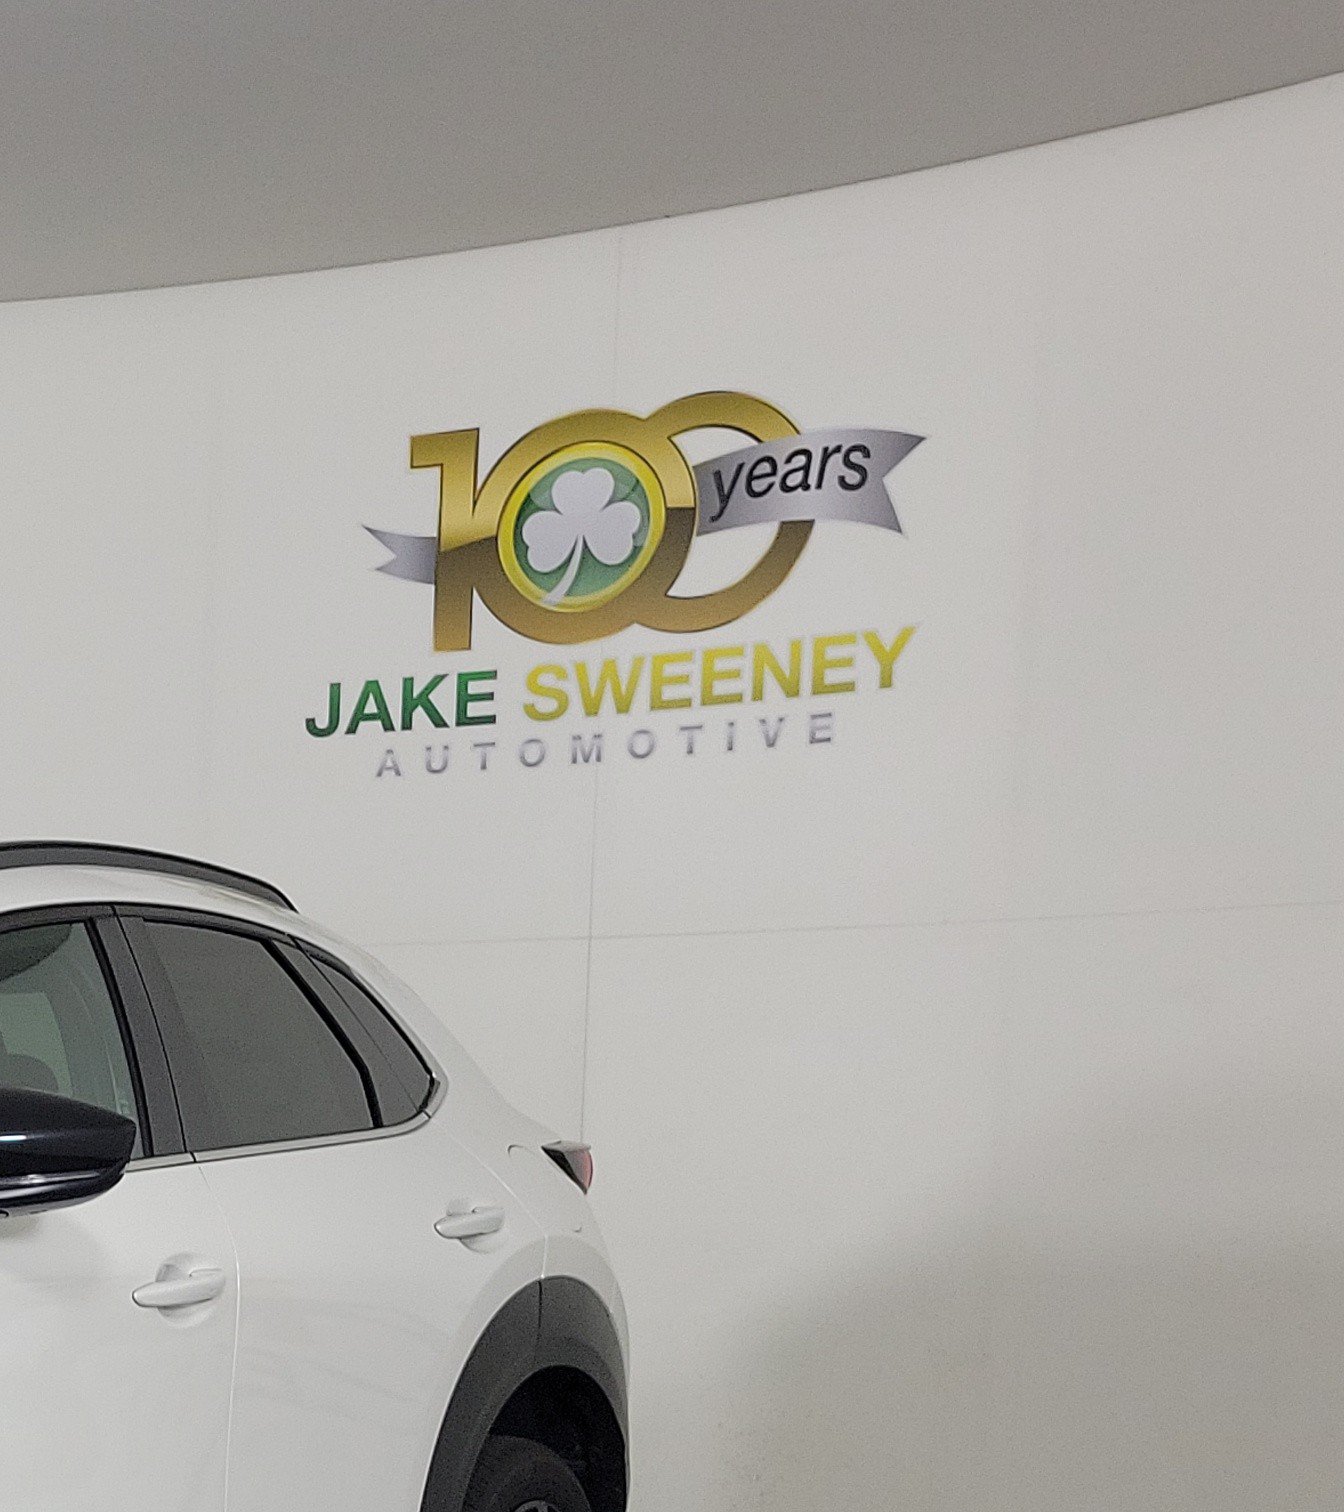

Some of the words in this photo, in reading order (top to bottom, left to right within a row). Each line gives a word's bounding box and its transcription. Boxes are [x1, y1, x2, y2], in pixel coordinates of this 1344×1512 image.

[410, 391, 815, 653] 100
[709, 440, 871, 523] years
[305, 669, 499, 739] JAKE
[522, 626, 916, 722] SWEENEY
[375, 712, 834, 778] AUTOMOTIVE
